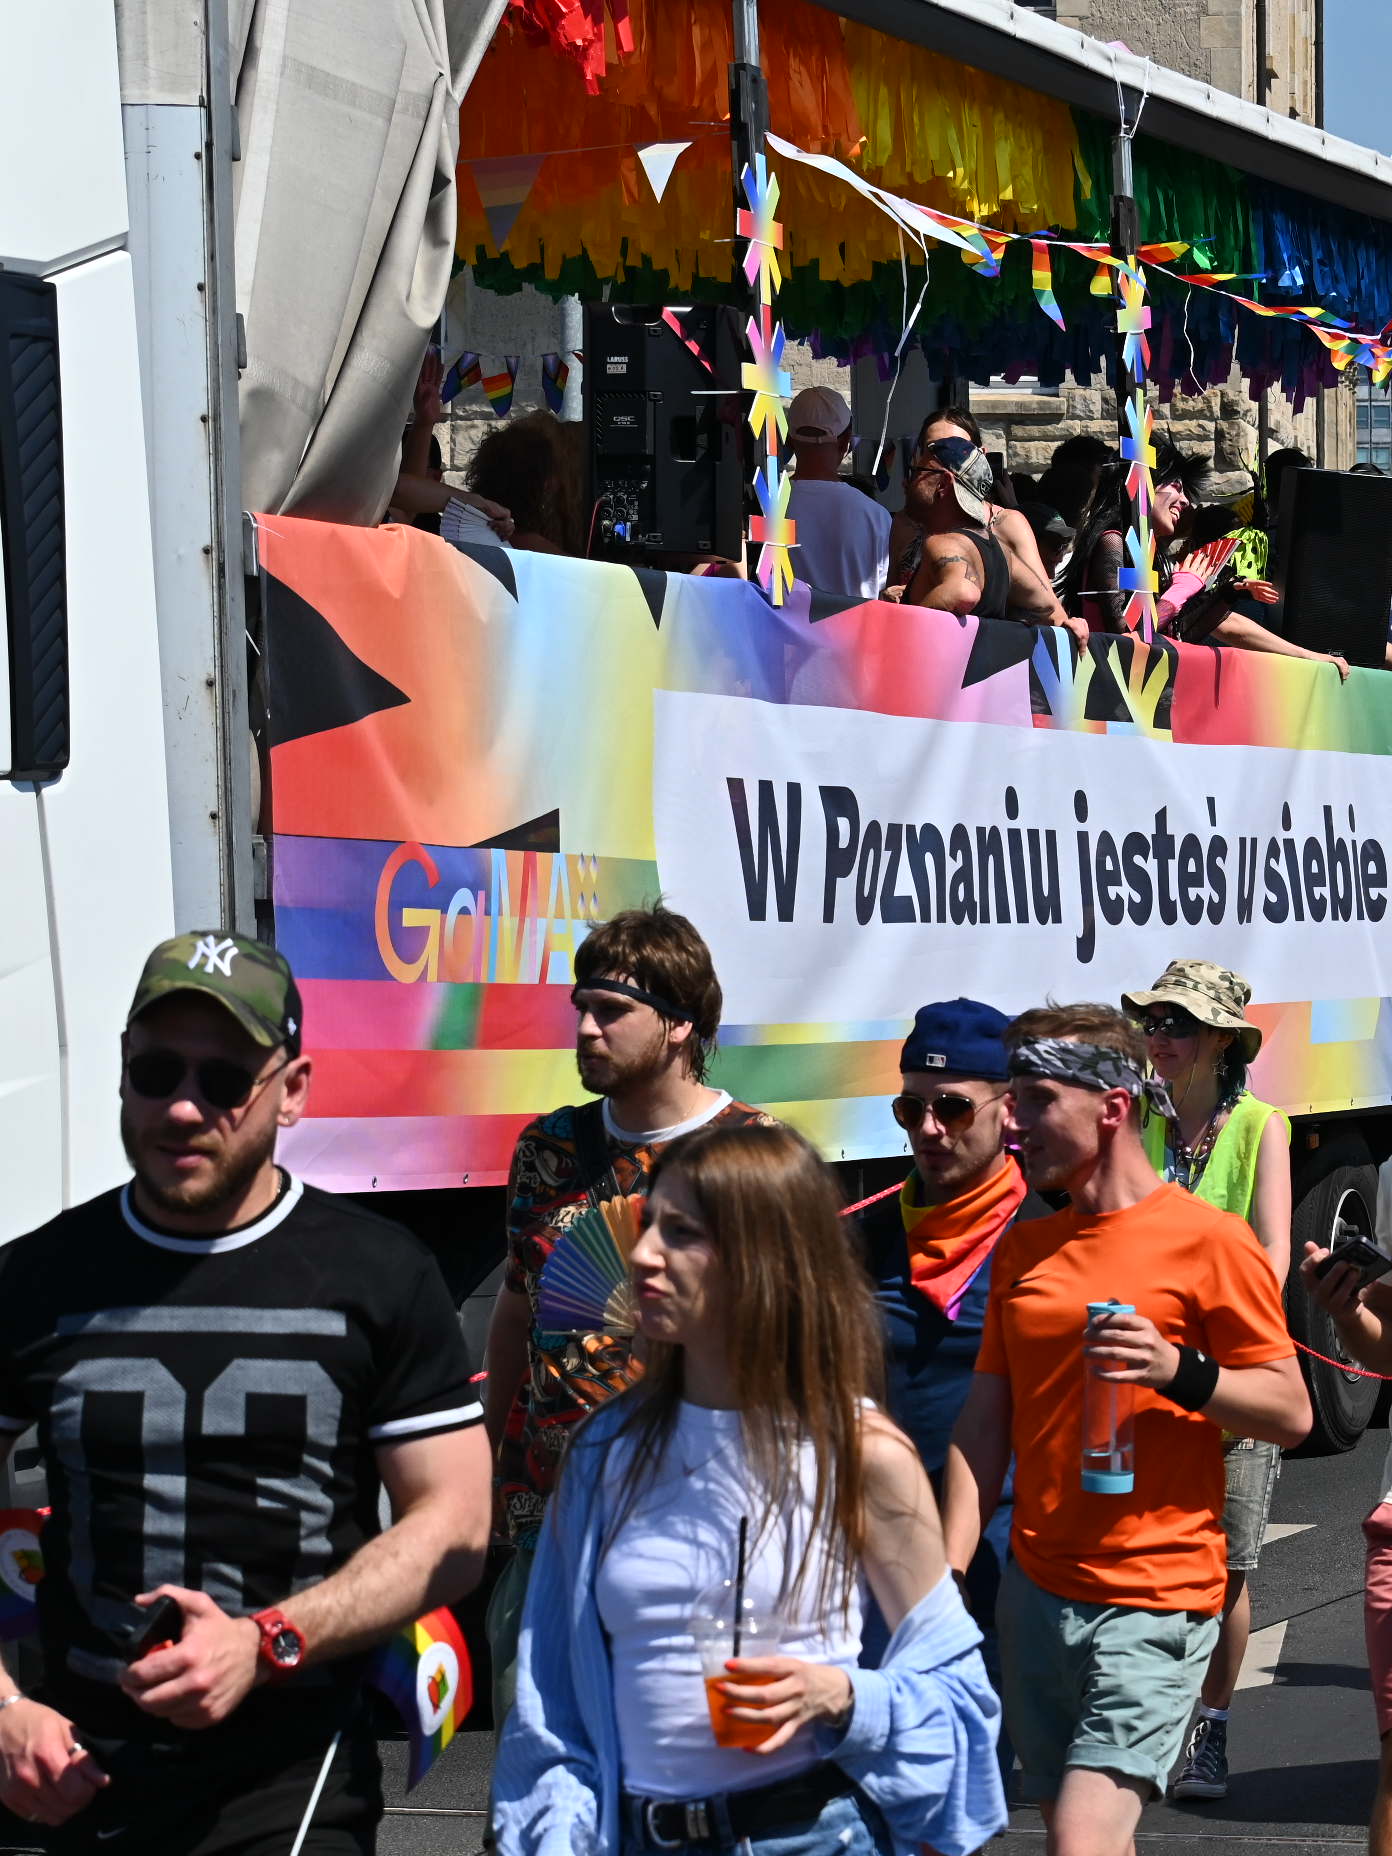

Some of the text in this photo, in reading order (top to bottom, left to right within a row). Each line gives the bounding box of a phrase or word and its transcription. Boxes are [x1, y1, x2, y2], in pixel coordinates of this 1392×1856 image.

[727, 777, 802, 923] W
[818, 785, 1063, 926] Poznaniu
[1073, 789, 1228, 964] jesteś
[1236, 836, 1258, 926] u
[1262, 801, 1388, 924] siebie
